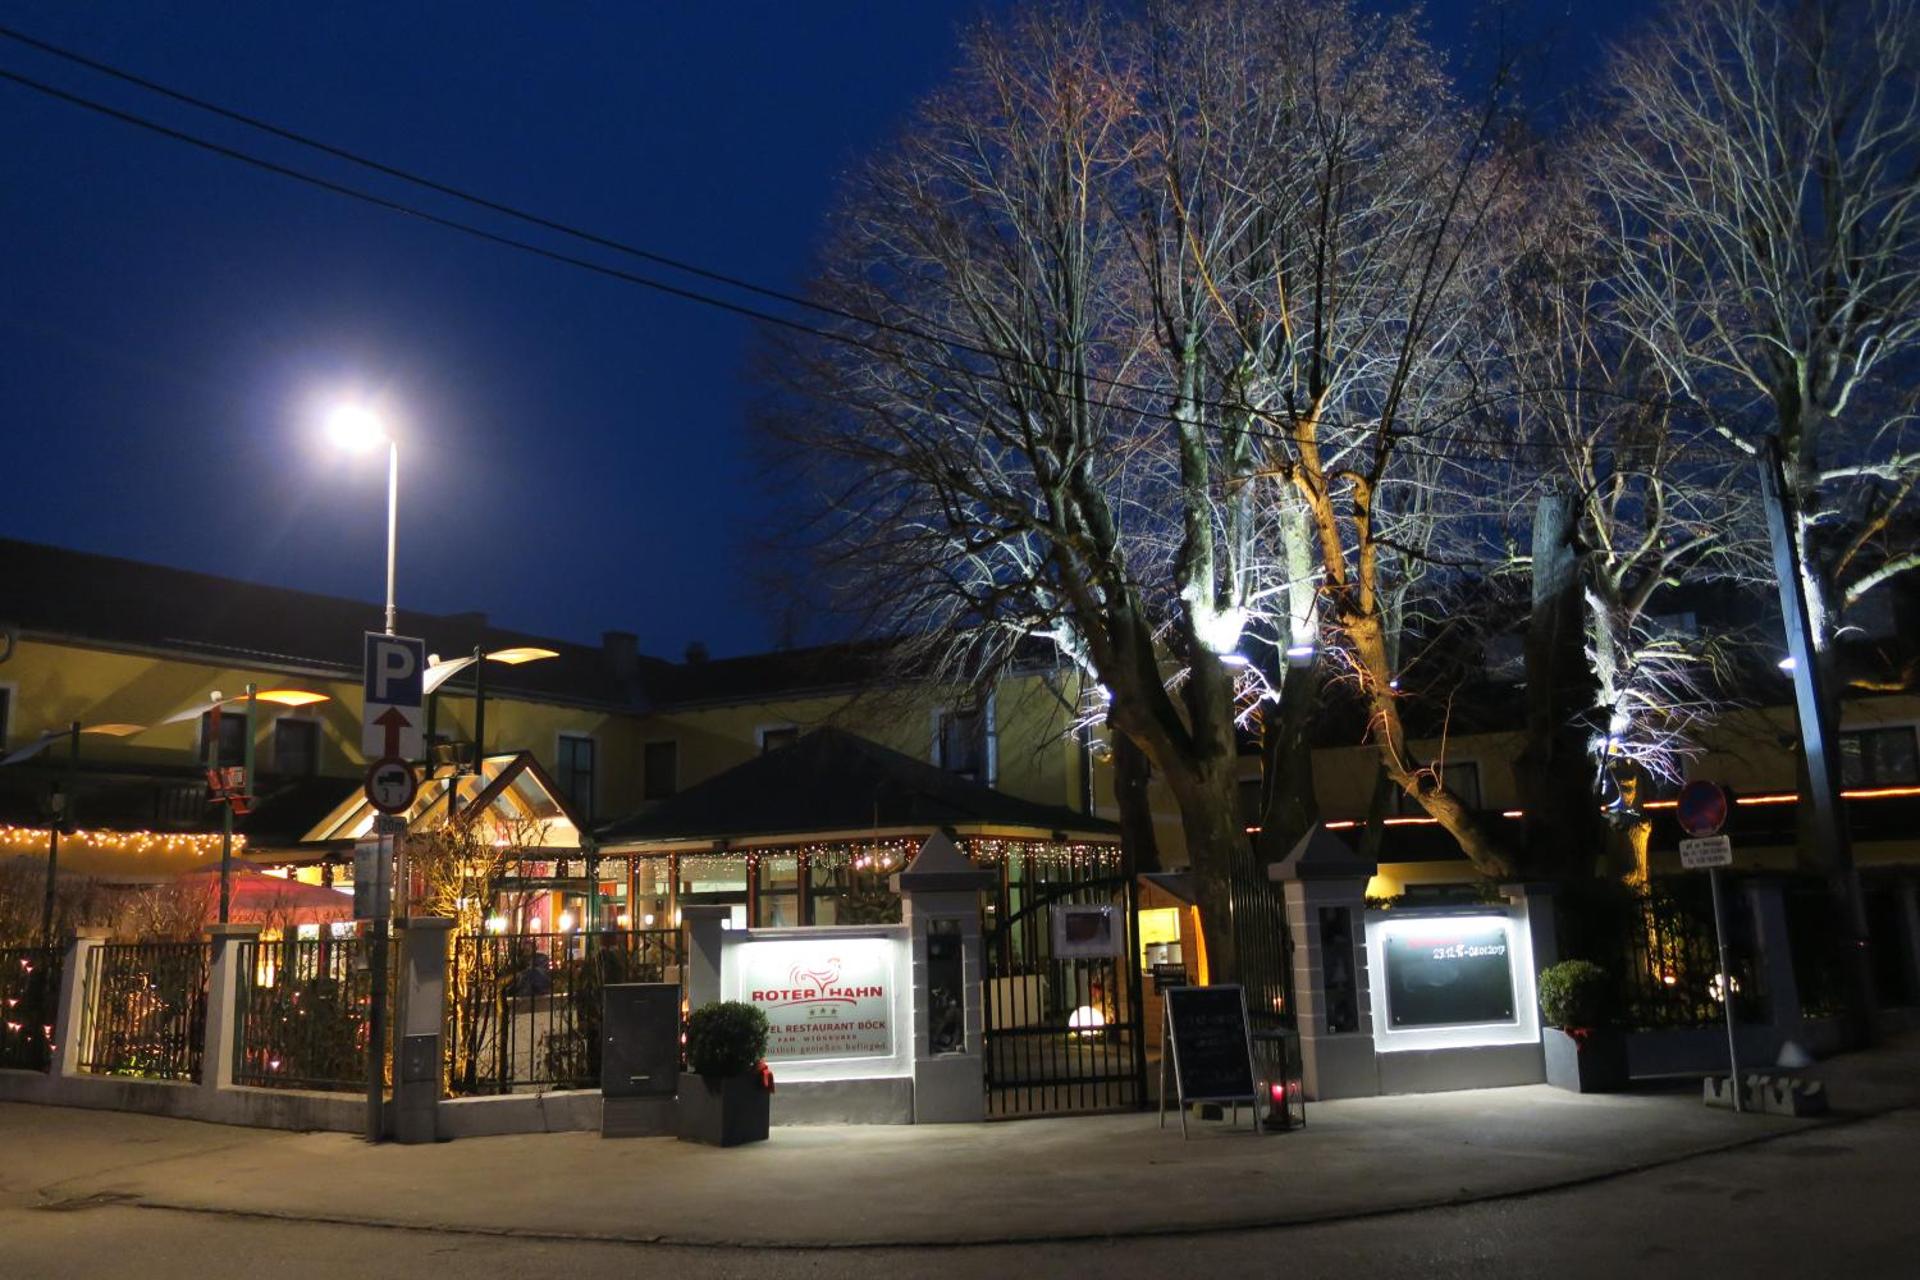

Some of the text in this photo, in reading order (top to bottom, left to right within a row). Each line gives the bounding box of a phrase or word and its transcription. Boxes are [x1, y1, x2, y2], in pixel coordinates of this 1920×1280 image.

[375, 641, 416, 699] P
[752, 986, 883, 1001] ROTER HAHN
[785, 1022, 855, 1033] RESTAURANT
[858, 1020, 886, 1030] BÖCK
